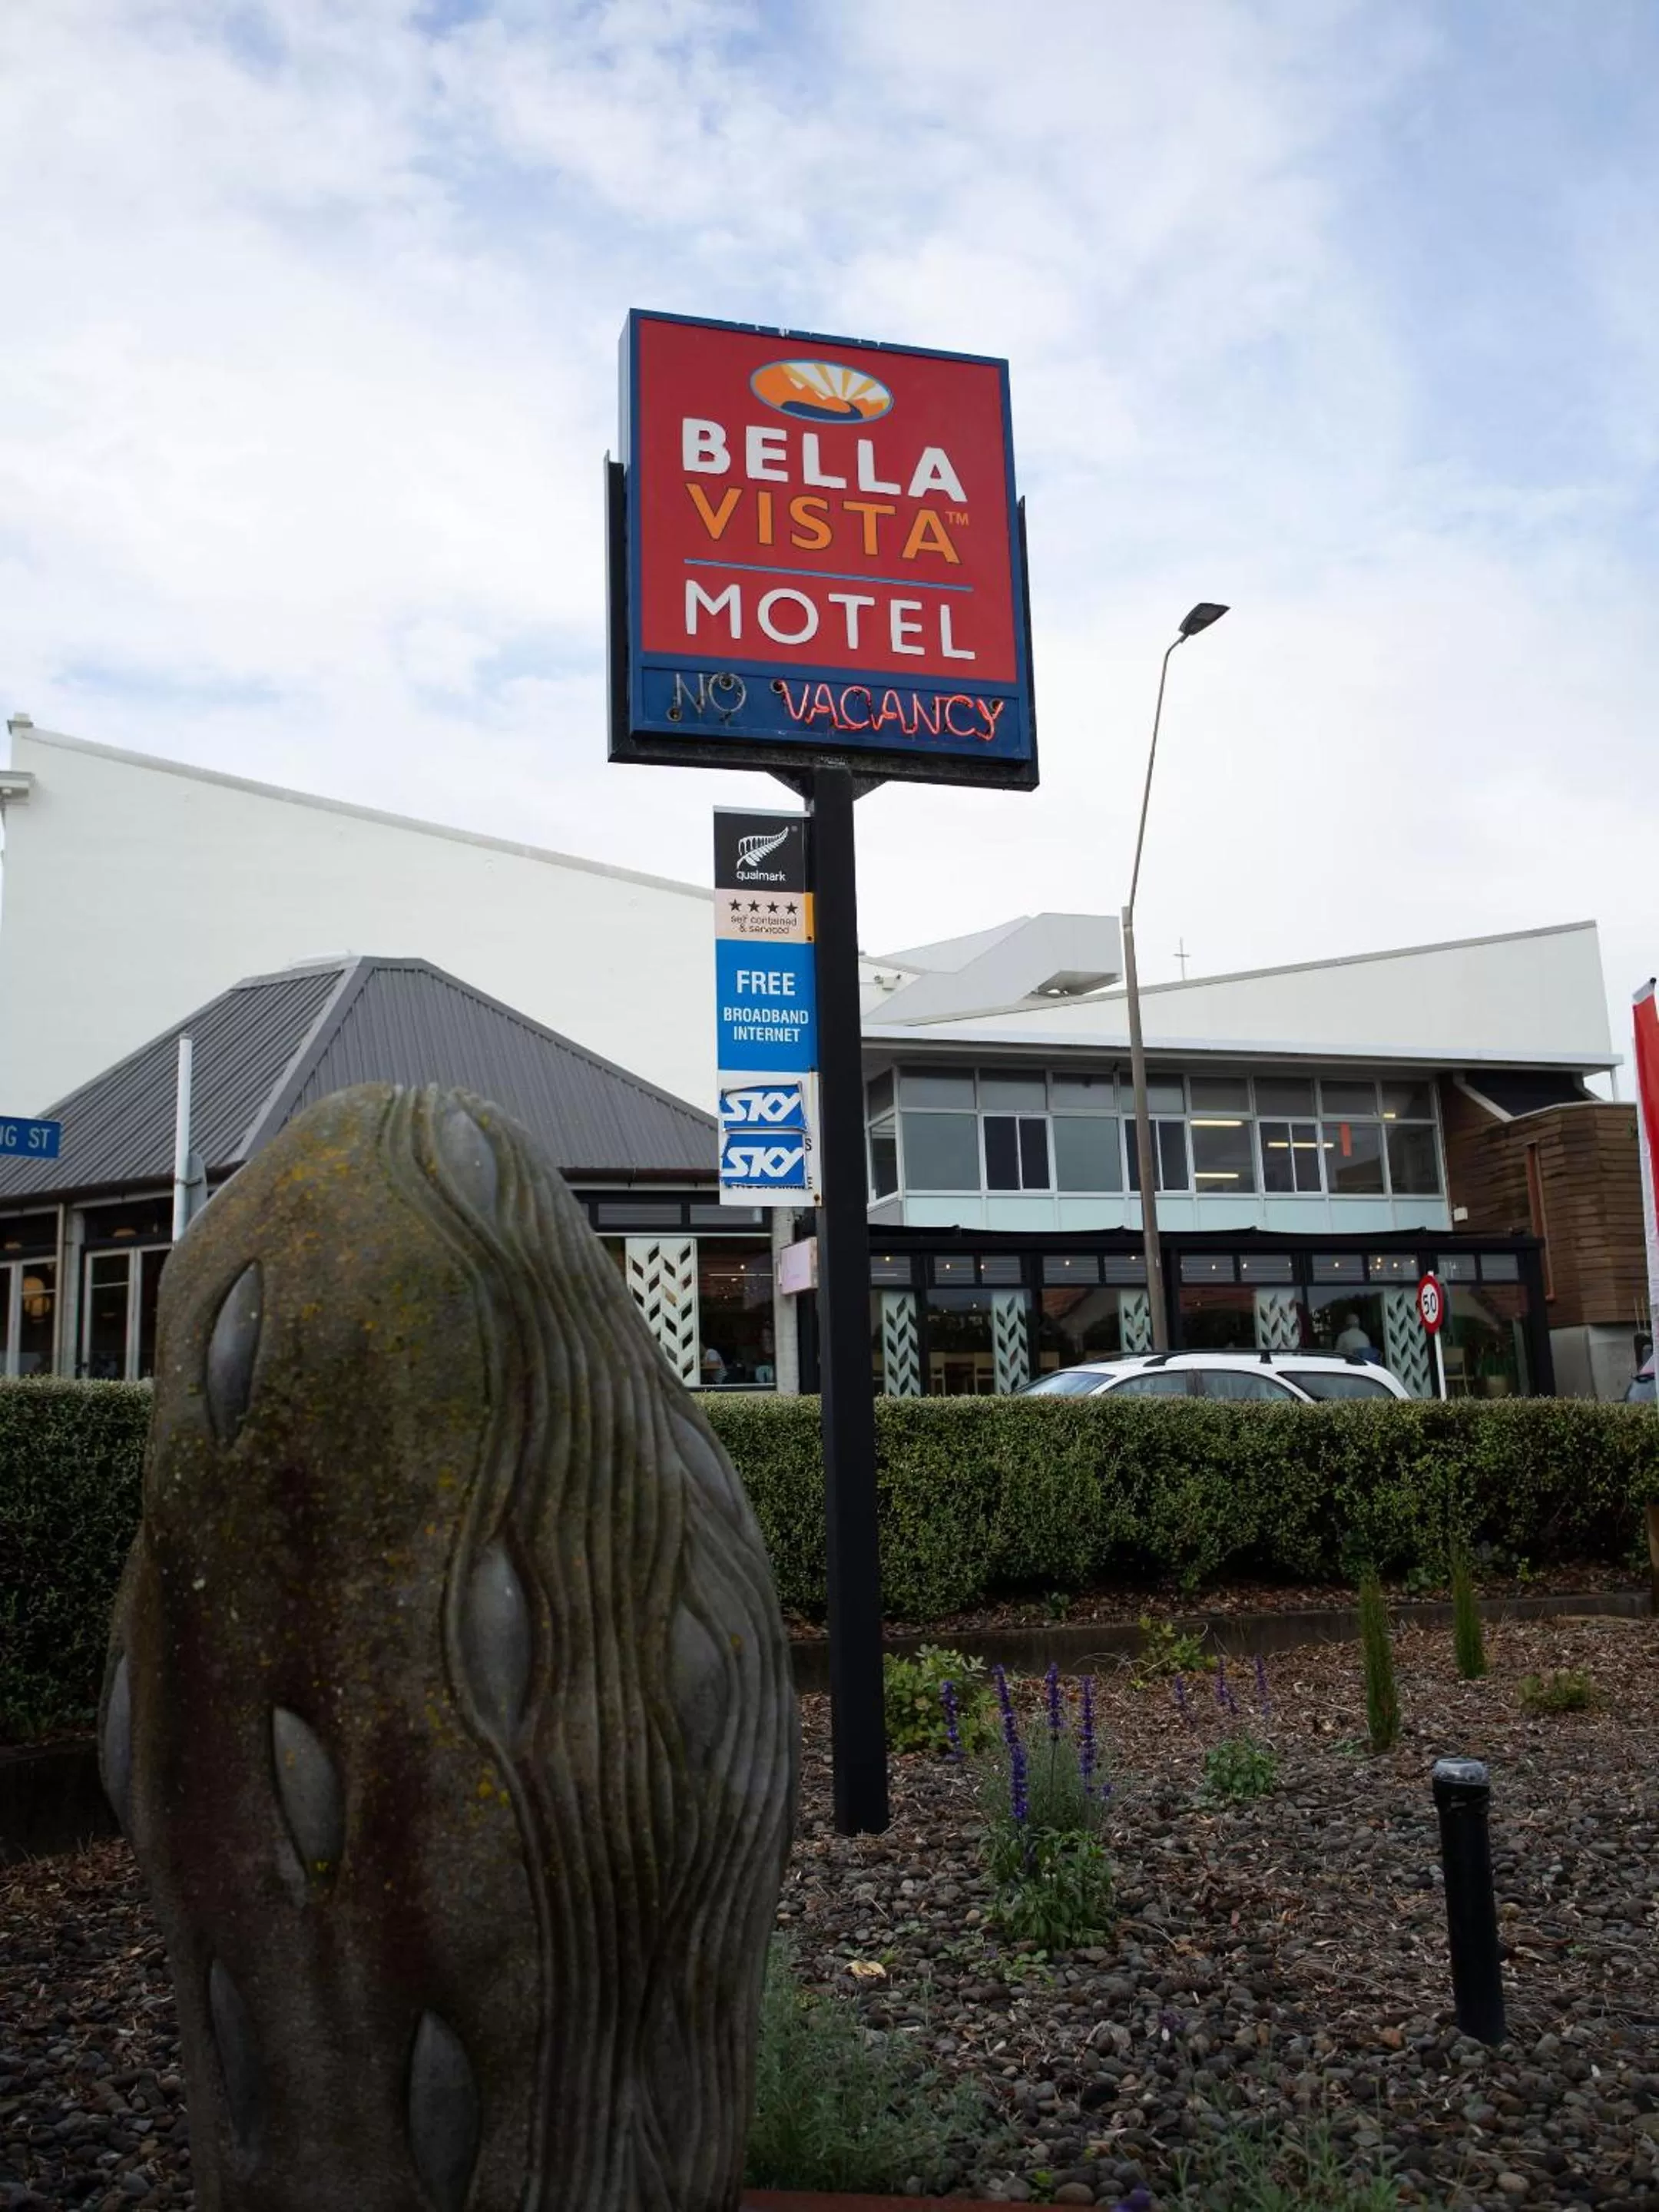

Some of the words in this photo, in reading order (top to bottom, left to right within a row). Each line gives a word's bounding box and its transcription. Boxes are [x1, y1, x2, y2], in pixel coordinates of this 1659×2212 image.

[681, 418, 968, 503] BELLA
[685, 483, 962, 565] VISTA
[685, 579, 975, 661] MOTEL
[671, 672, 747, 717] NO
[776, 680, 1004, 741] VACANCY
[736, 869, 786, 882] qualmark
[750, 916, 797, 926] contained
[737, 970, 796, 996] FREE
[724, 1007, 809, 1025] BROADBAND
[733, 1026, 801, 1042] INTERNET
[722, 1092, 803, 1121] SKY
[28, 1127, 52, 1149] ST
[721, 1147, 804, 1177] SKY
[1423, 1292, 1437, 1315] 50
